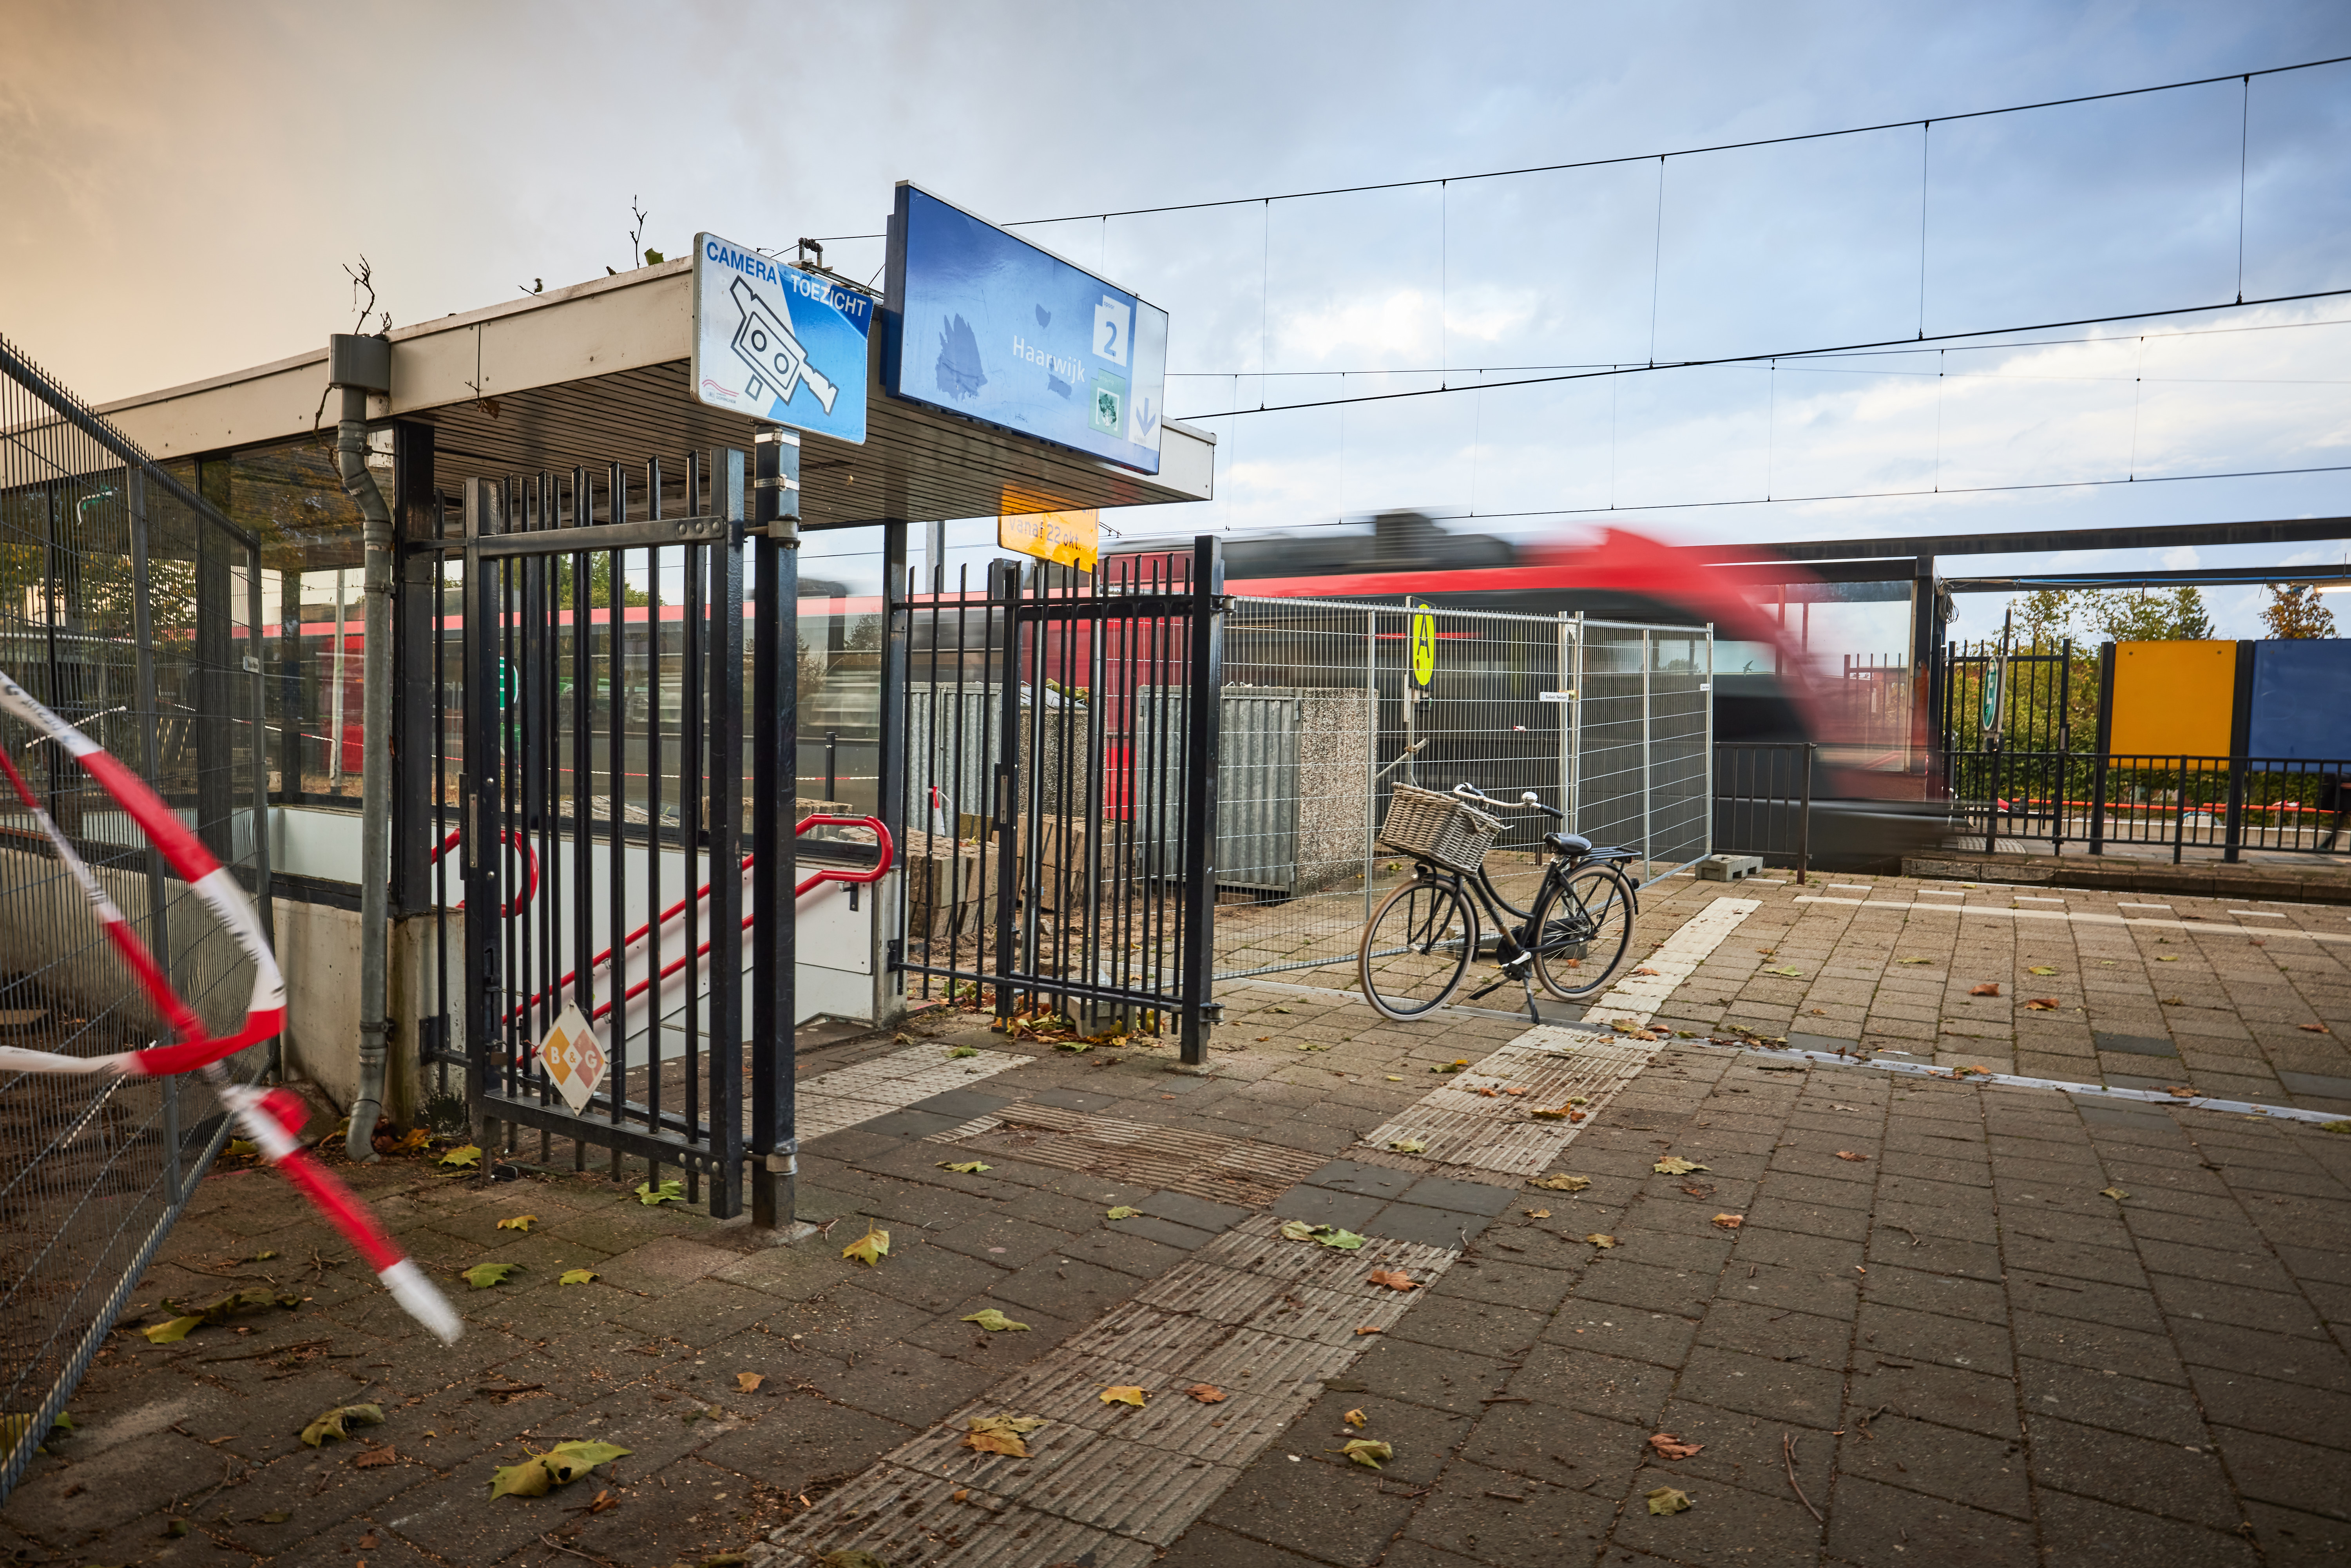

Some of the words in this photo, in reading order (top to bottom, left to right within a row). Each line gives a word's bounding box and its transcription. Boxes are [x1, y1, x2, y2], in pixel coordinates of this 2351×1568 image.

[706, 241, 777, 285] CAMERA
[791, 274, 866, 317] TOEZICHT
[1104, 301, 1115, 310] spoor
[1104, 321, 1117, 357] 2
[1013, 335, 1085, 384] Haarwijk
[716, 395, 736, 404] GORINCHEM
[1047, 523, 1060, 544] 22
[1063, 531, 1081, 550] okt.
[1417, 612, 1430, 658] A
[551, 1046, 560, 1064] B
[569, 1052, 576, 1063] &
[585, 1050, 597, 1068] G
